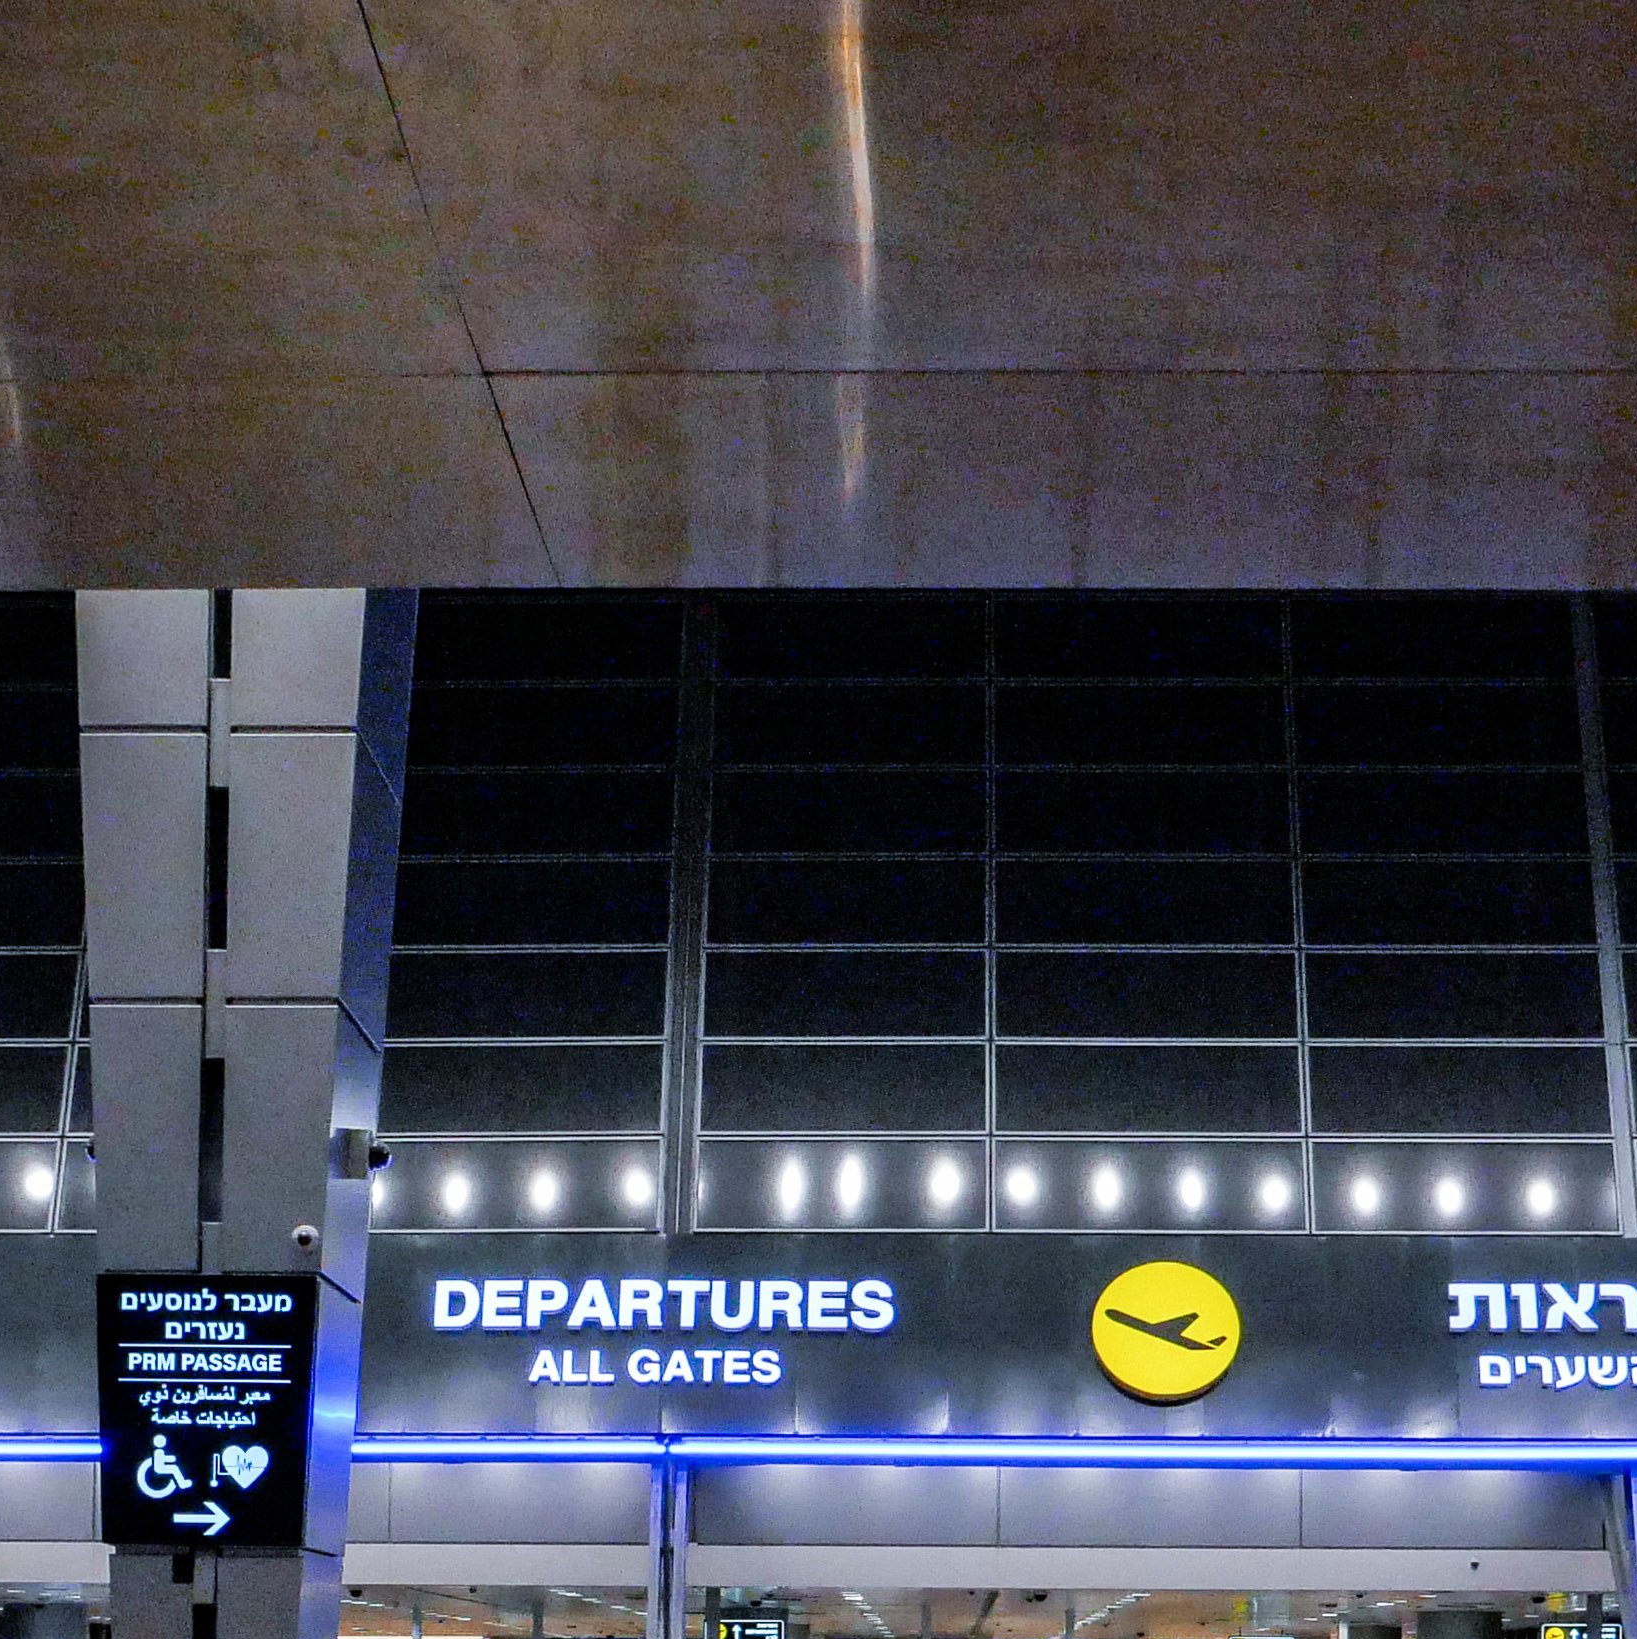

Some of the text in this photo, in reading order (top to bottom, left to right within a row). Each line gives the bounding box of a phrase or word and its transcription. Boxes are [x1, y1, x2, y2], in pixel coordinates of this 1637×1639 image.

[121, 1288, 292, 1313] מעבר לנוסעים
[434, 1279, 894, 1331] DEPARTURES
[165, 1321, 245, 1341] נעזרים
[128, 1352, 282, 1373] PRM PASSAGE
[528, 1348, 782, 1384] ALL GATES
[151, 1409, 256, 1429] احتياجات خاصة
